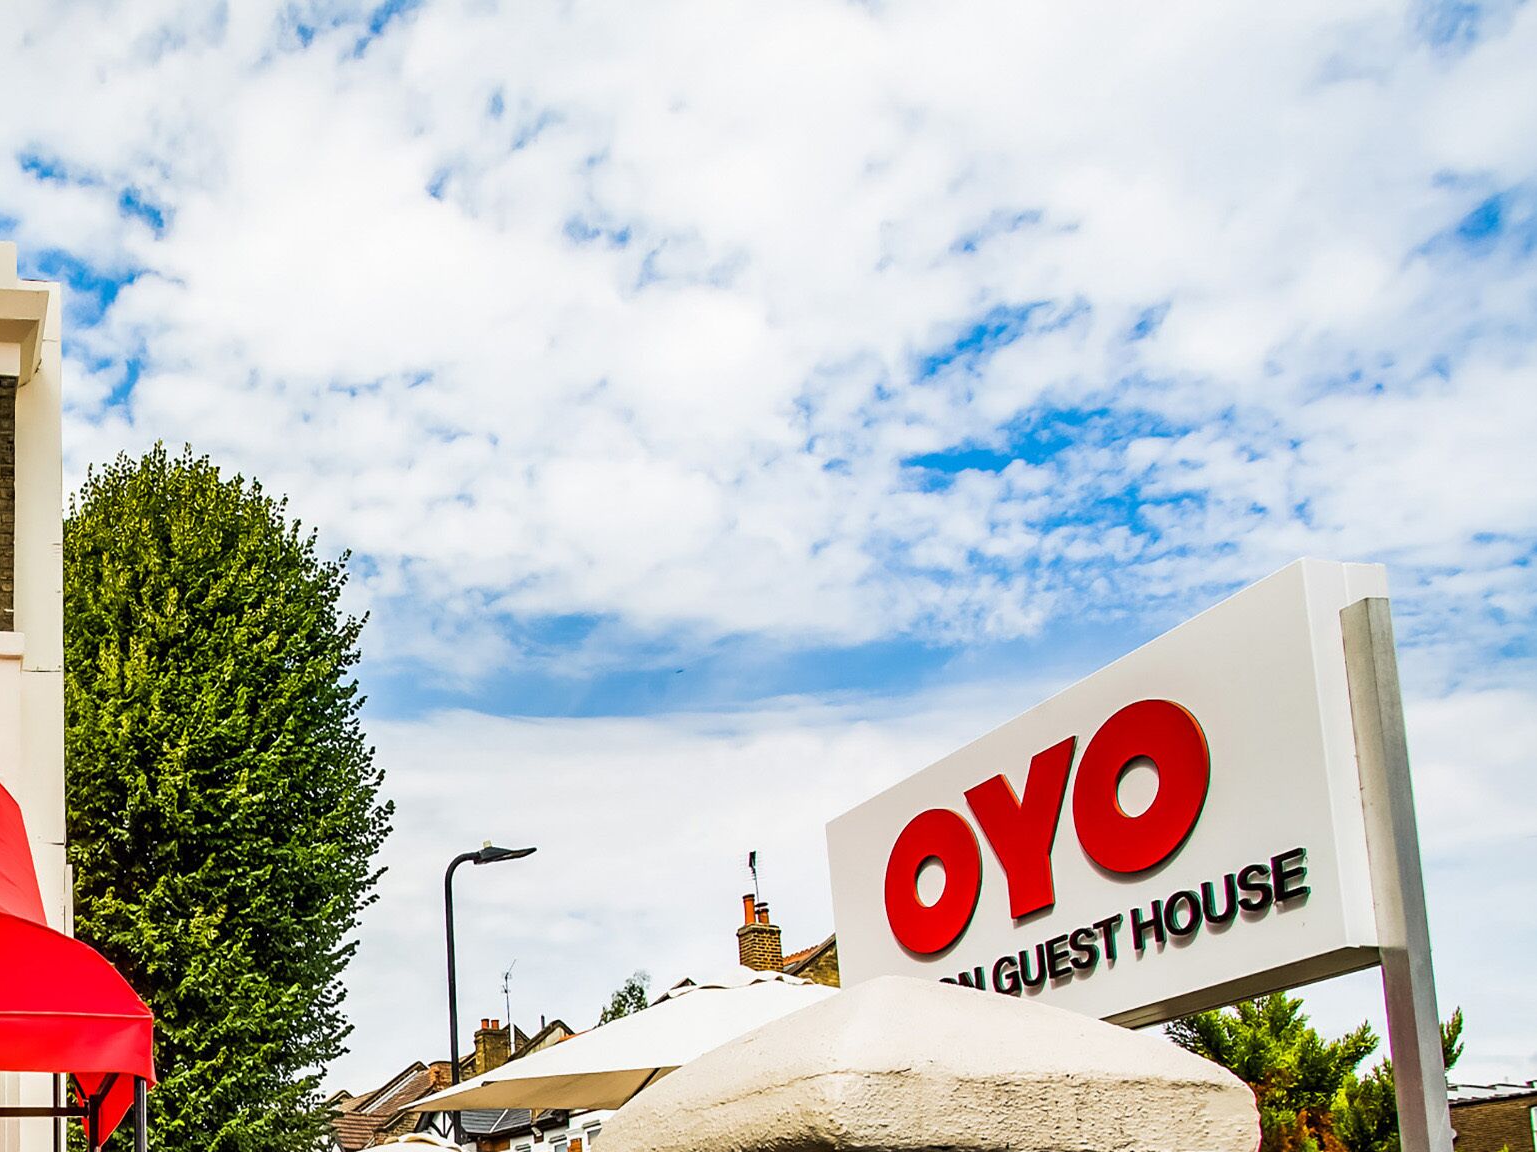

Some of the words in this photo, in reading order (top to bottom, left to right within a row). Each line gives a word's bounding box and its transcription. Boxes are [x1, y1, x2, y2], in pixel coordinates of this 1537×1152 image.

[884, 699, 1210, 958] OYO
[993, 914, 1123, 997] GUEST
[1130, 847, 1311, 955] HOUSE
